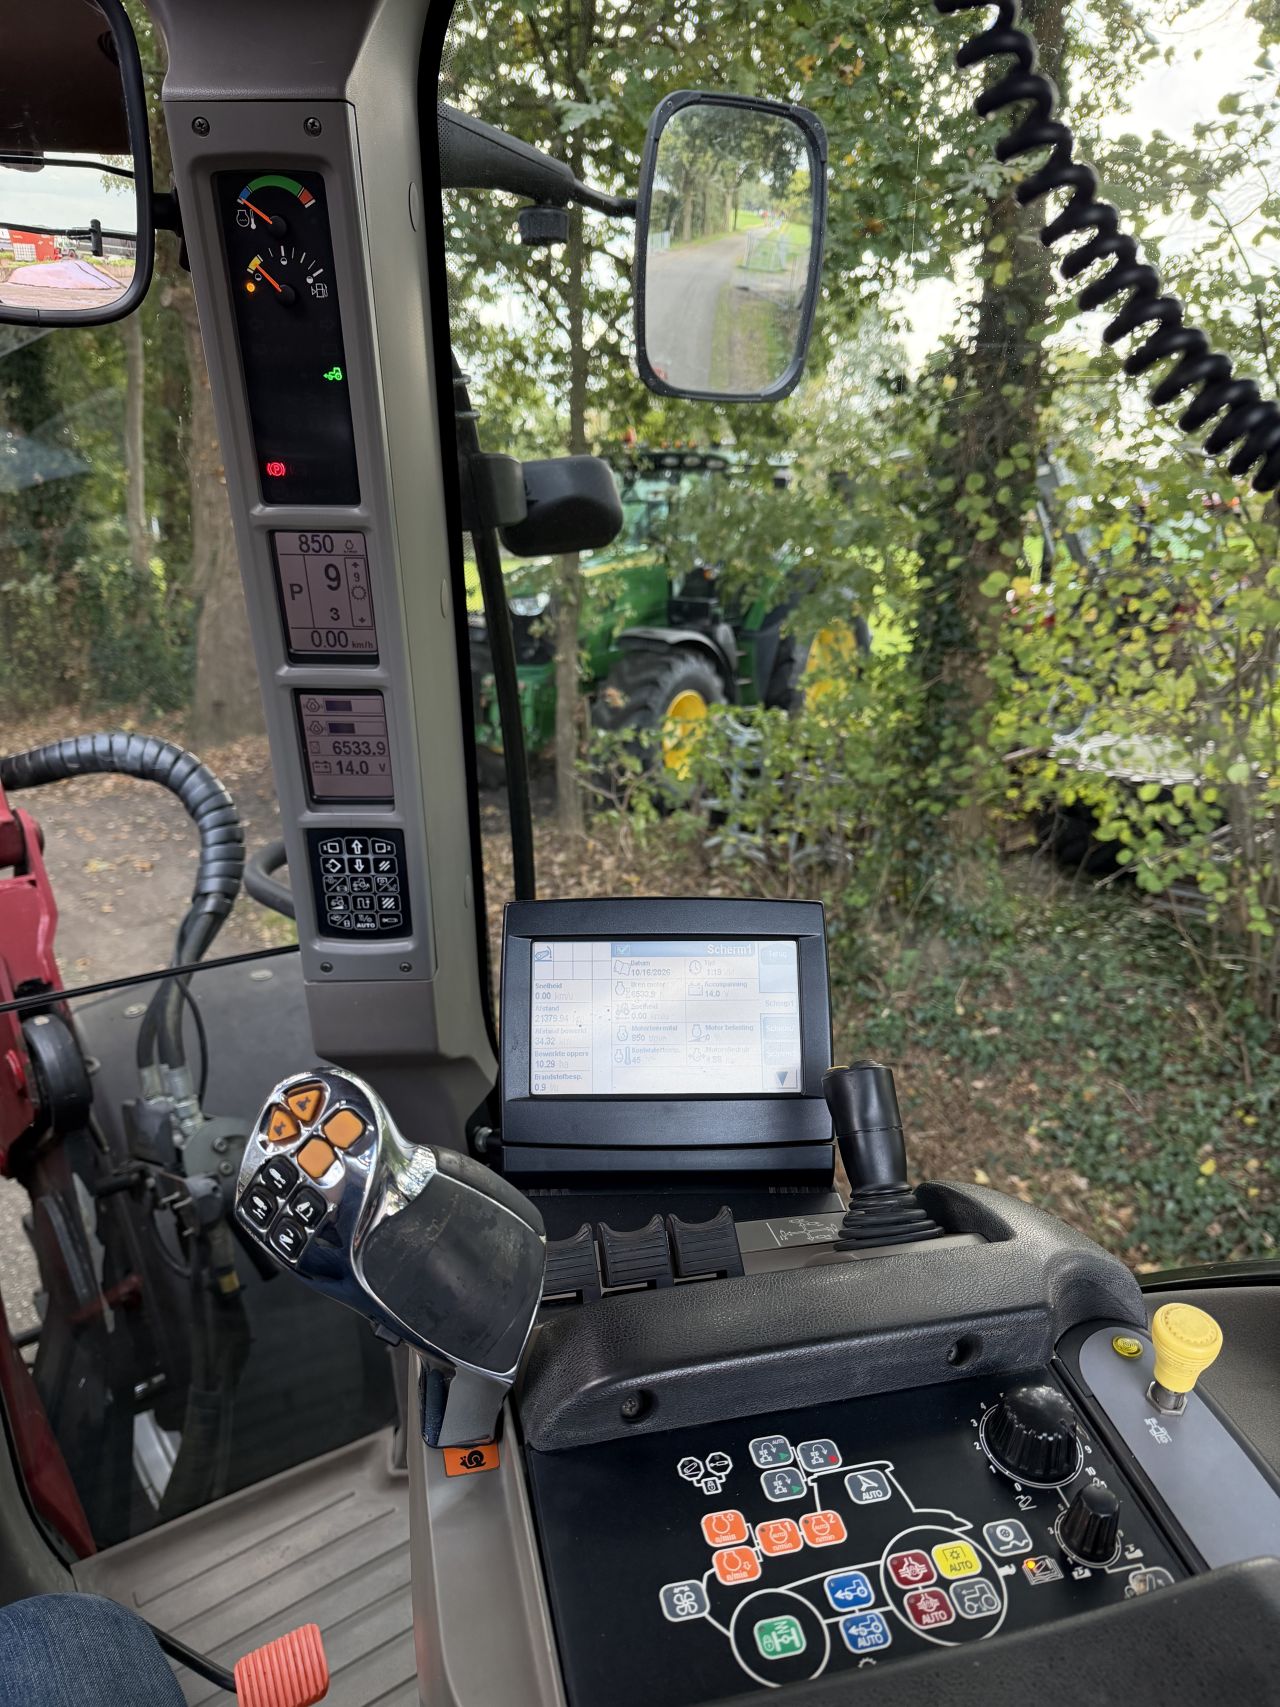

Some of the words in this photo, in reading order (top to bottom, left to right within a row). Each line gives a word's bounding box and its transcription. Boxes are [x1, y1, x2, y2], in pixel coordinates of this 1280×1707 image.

[299, 534, 334, 554] 850
[324, 563, 342, 591] 9
[353, 572, 361, 583] 9
[290, 583, 303, 600] P
[329, 607, 341, 621] 3
[311, 630, 349, 648] 0.00
[352, 641, 374, 649] km/h
[332, 741, 386, 755] 6533.9
[336, 760, 369, 775] 14.0
[980, 1402, 987, 1410] 4
[970, 1418, 978, 1427] 3
[973, 1441, 981, 1450] 2
[1084, 1445, 1093, 1454] 9
[989, 1465, 997, 1474] 1
[1085, 1466, 1097, 1476] 10
[1014, 1482, 1022, 1492] 0
[862, 1489, 883, 1500] AUTO
[827, 1513, 837, 1523] 2
[784, 1522, 792, 1532] 1
[1047, 1526, 1055, 1535] 3
[815, 1534, 836, 1543] n/min
[772, 1543, 793, 1551] n/min
[1067, 1556, 1074, 1565] 1
[949, 1560, 973, 1573] AUTO
[726, 1571, 749, 1581] n/min
[921, 1611, 948, 1625] AUTO
[857, 1635, 884, 1648] AUTO
